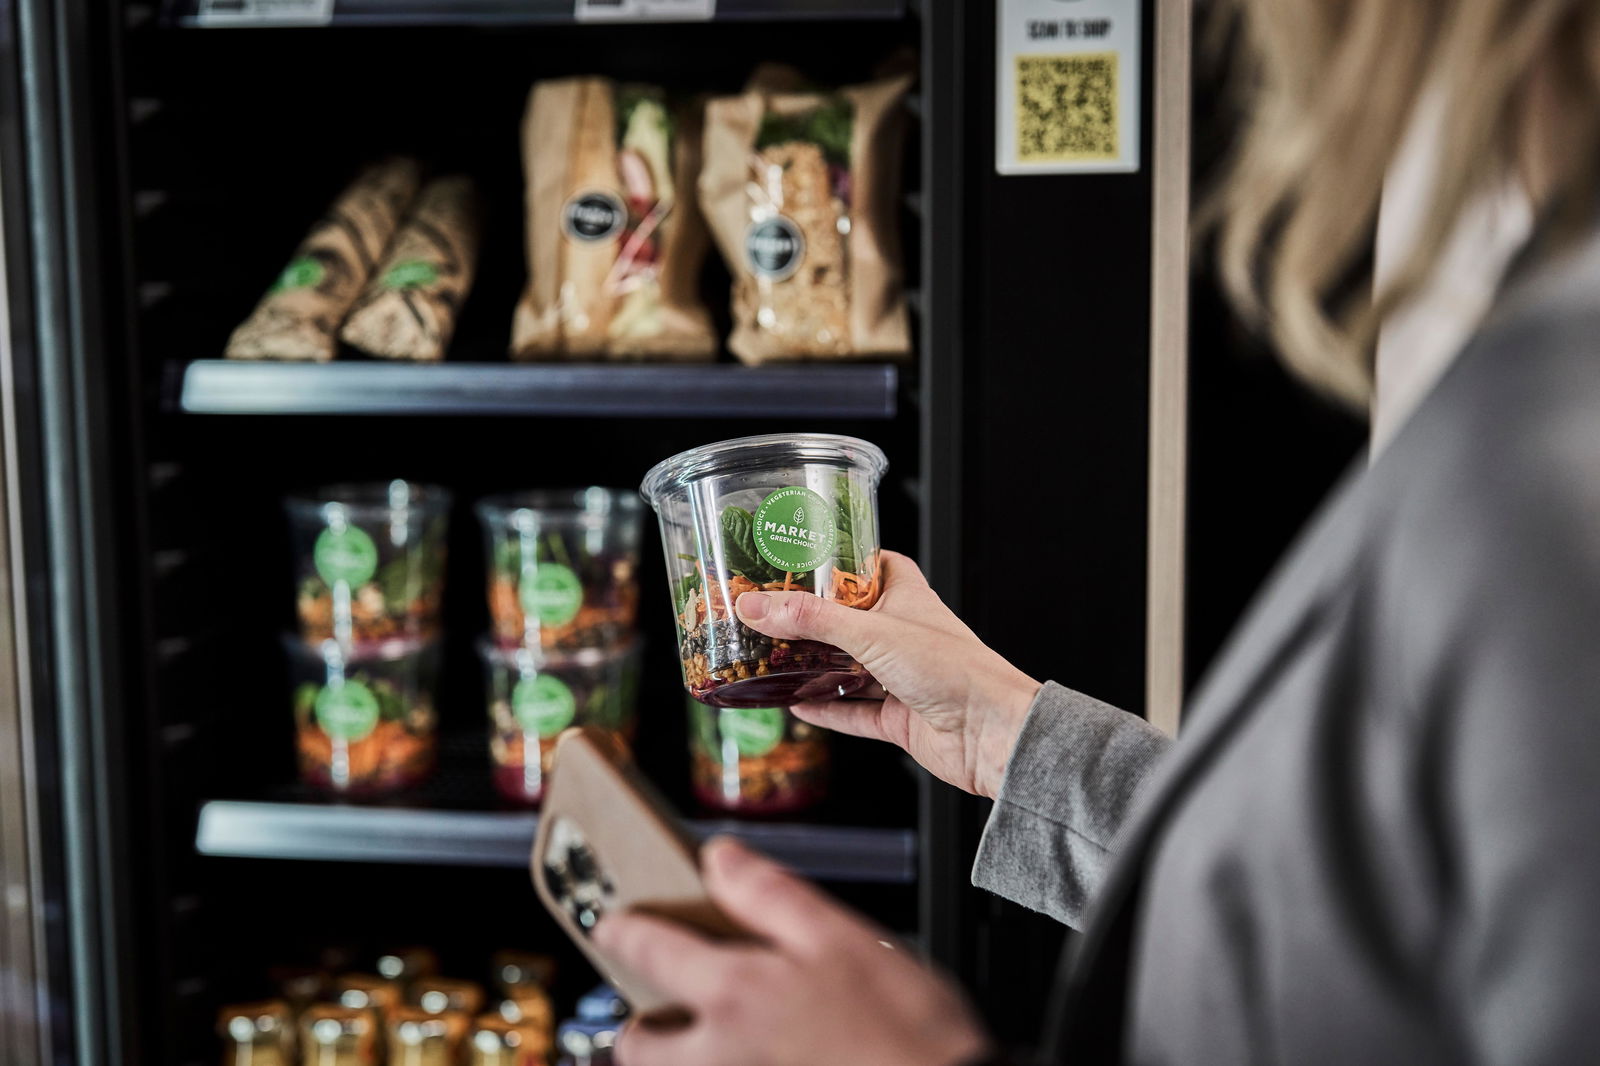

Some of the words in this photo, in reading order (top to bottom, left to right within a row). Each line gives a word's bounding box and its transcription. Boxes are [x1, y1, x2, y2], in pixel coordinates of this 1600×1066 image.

[756, 509, 766, 536] CHOICE
[764, 521, 826, 544] MARKET
[769, 534, 793, 544] GREEN
[792, 539, 818, 550] CHOICE
[797, 557, 822, 568] CHOICE
